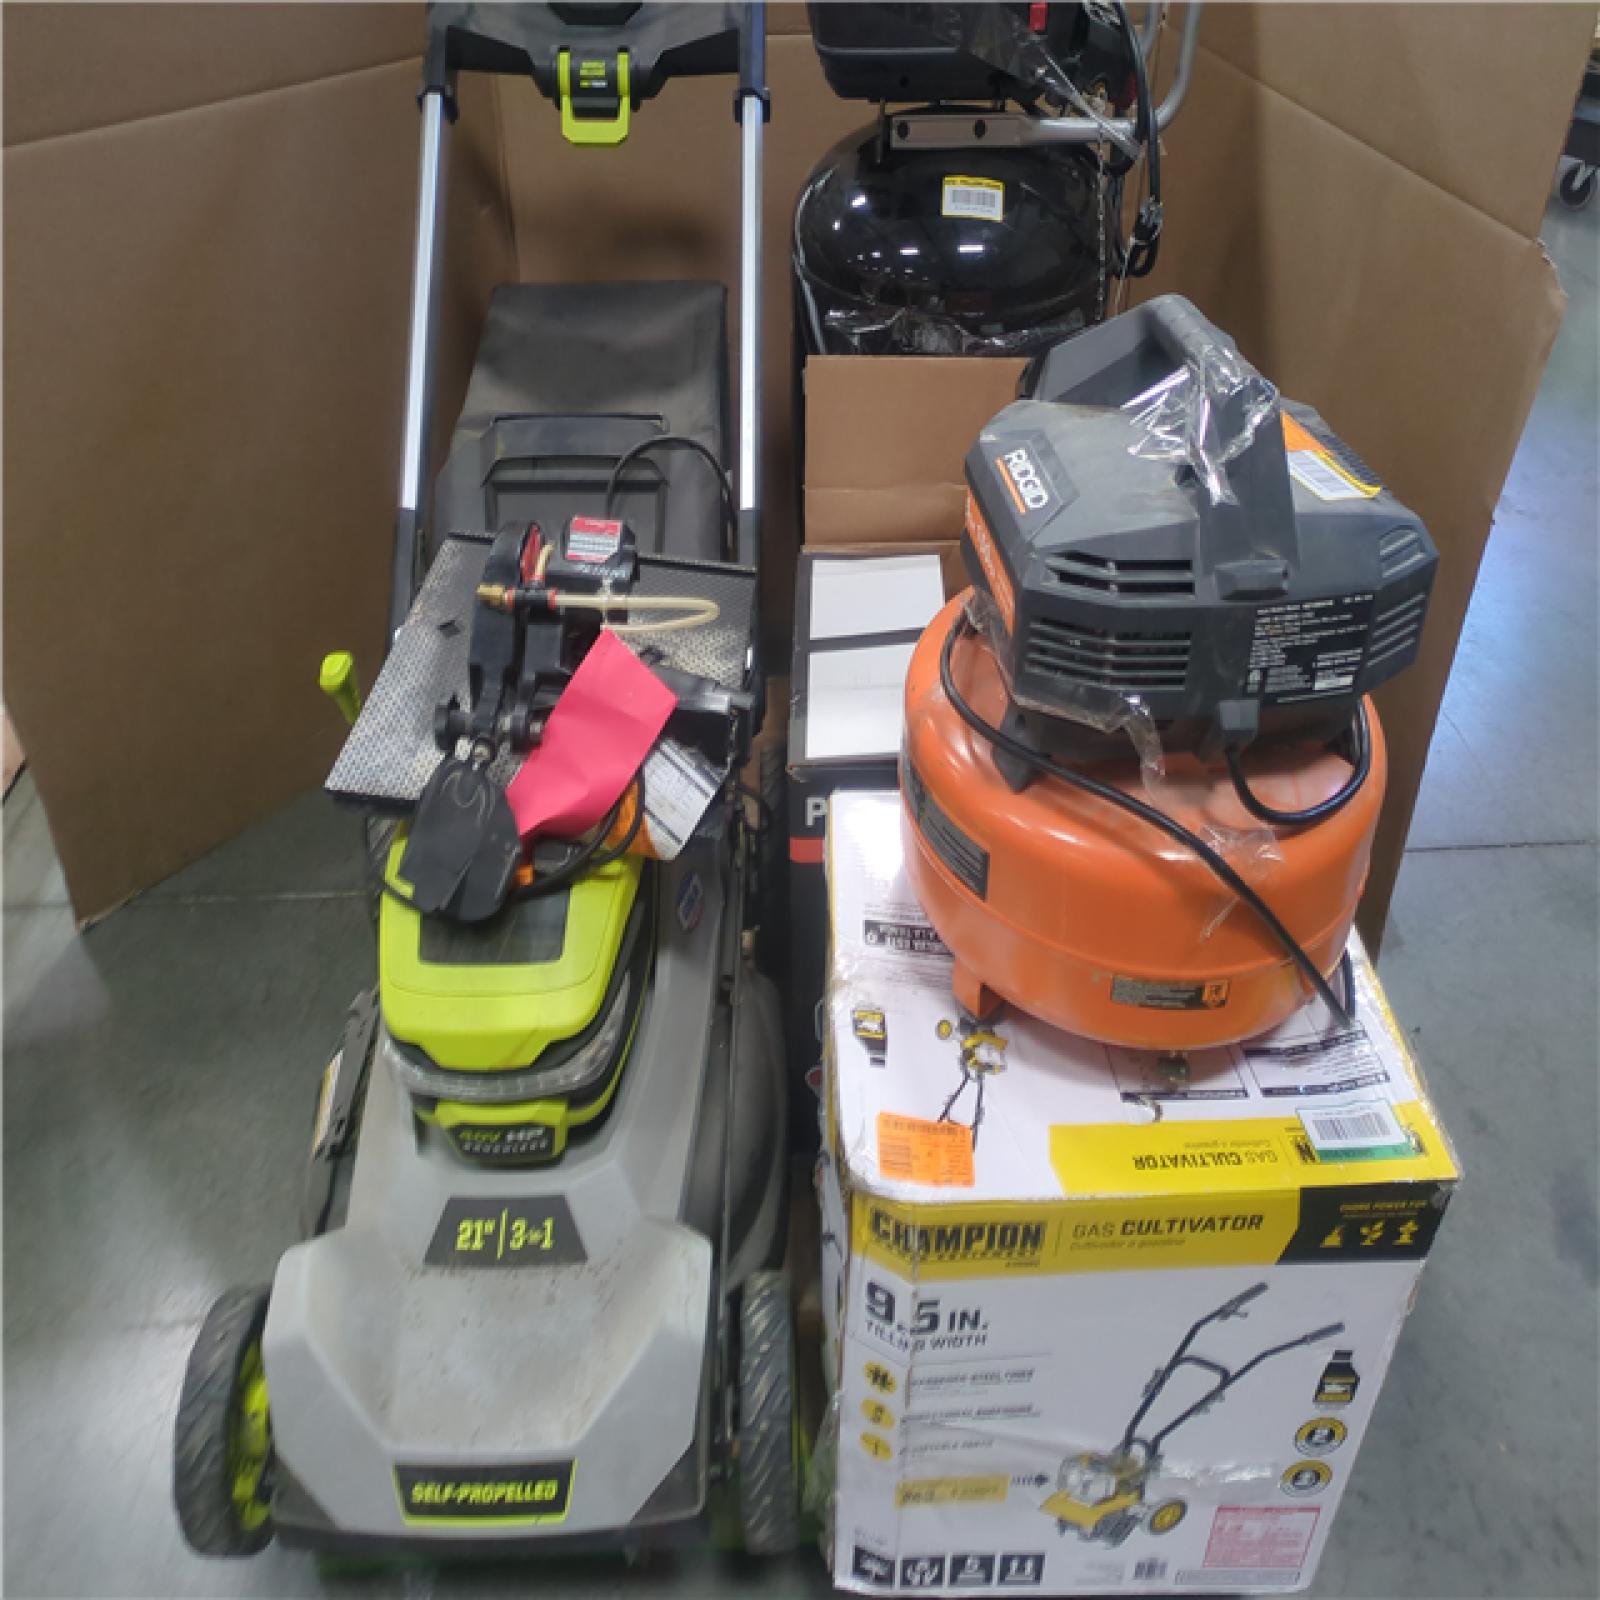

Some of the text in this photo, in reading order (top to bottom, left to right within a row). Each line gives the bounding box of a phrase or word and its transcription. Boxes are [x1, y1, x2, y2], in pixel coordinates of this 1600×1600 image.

[1004, 449, 1048, 509] RIDGID
[872, 1208, 1043, 1253] CHAMPION
[1072, 1214, 1264, 1240] GAS CULTIVATOR
[866, 1281, 989, 1336] 9.5 IN.
[930, 1333, 989, 1350] WIDTH
[411, 1479, 559, 1505] SELF-PROPELLED
